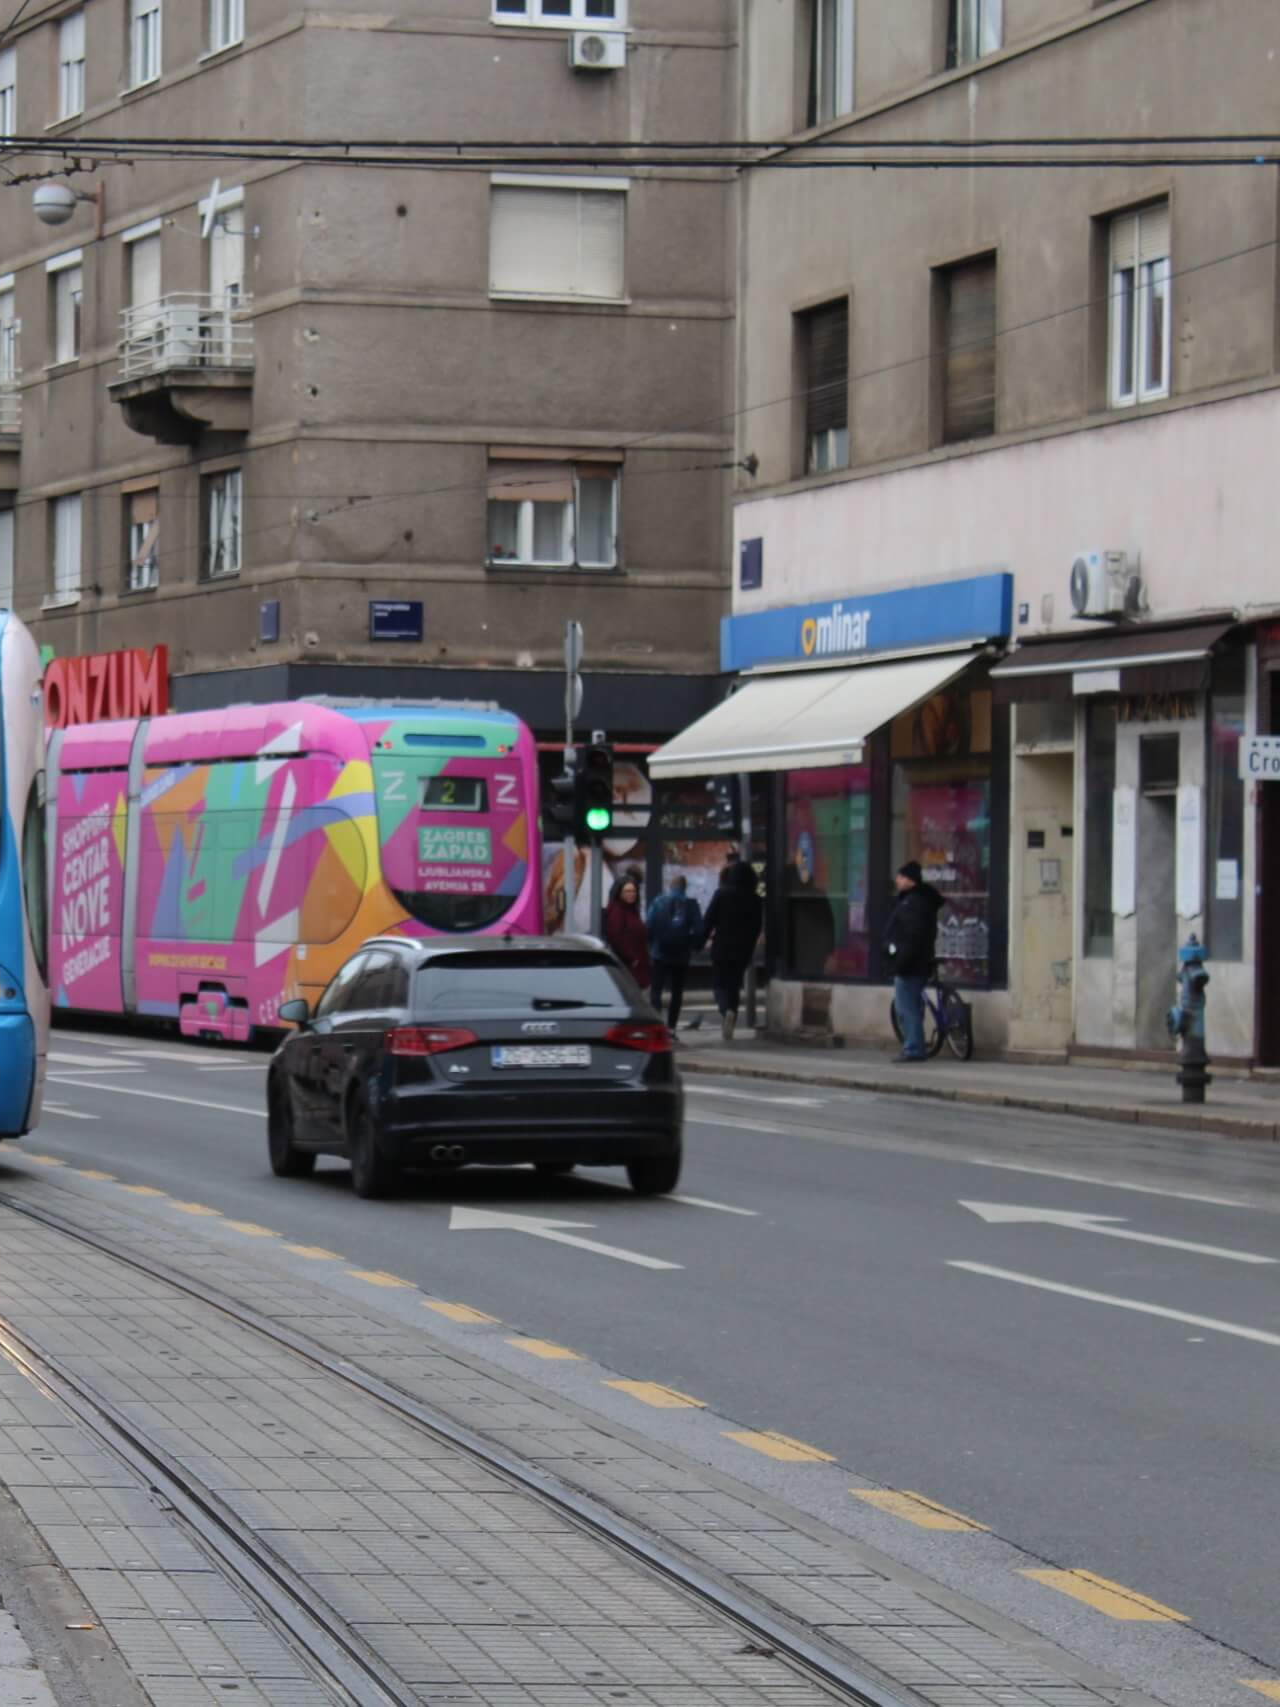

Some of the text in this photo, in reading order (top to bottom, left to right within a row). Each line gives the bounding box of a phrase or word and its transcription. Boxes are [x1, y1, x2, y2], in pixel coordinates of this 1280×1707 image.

[816, 602, 871, 655] mlinar
[441, 781, 456, 803] 2
[423, 831, 486, 844] ZAGREB
[423, 844, 489, 861] ZAPAD
[63, 836, 110, 897] CENTAR
[62, 874, 111, 953] NOVE
